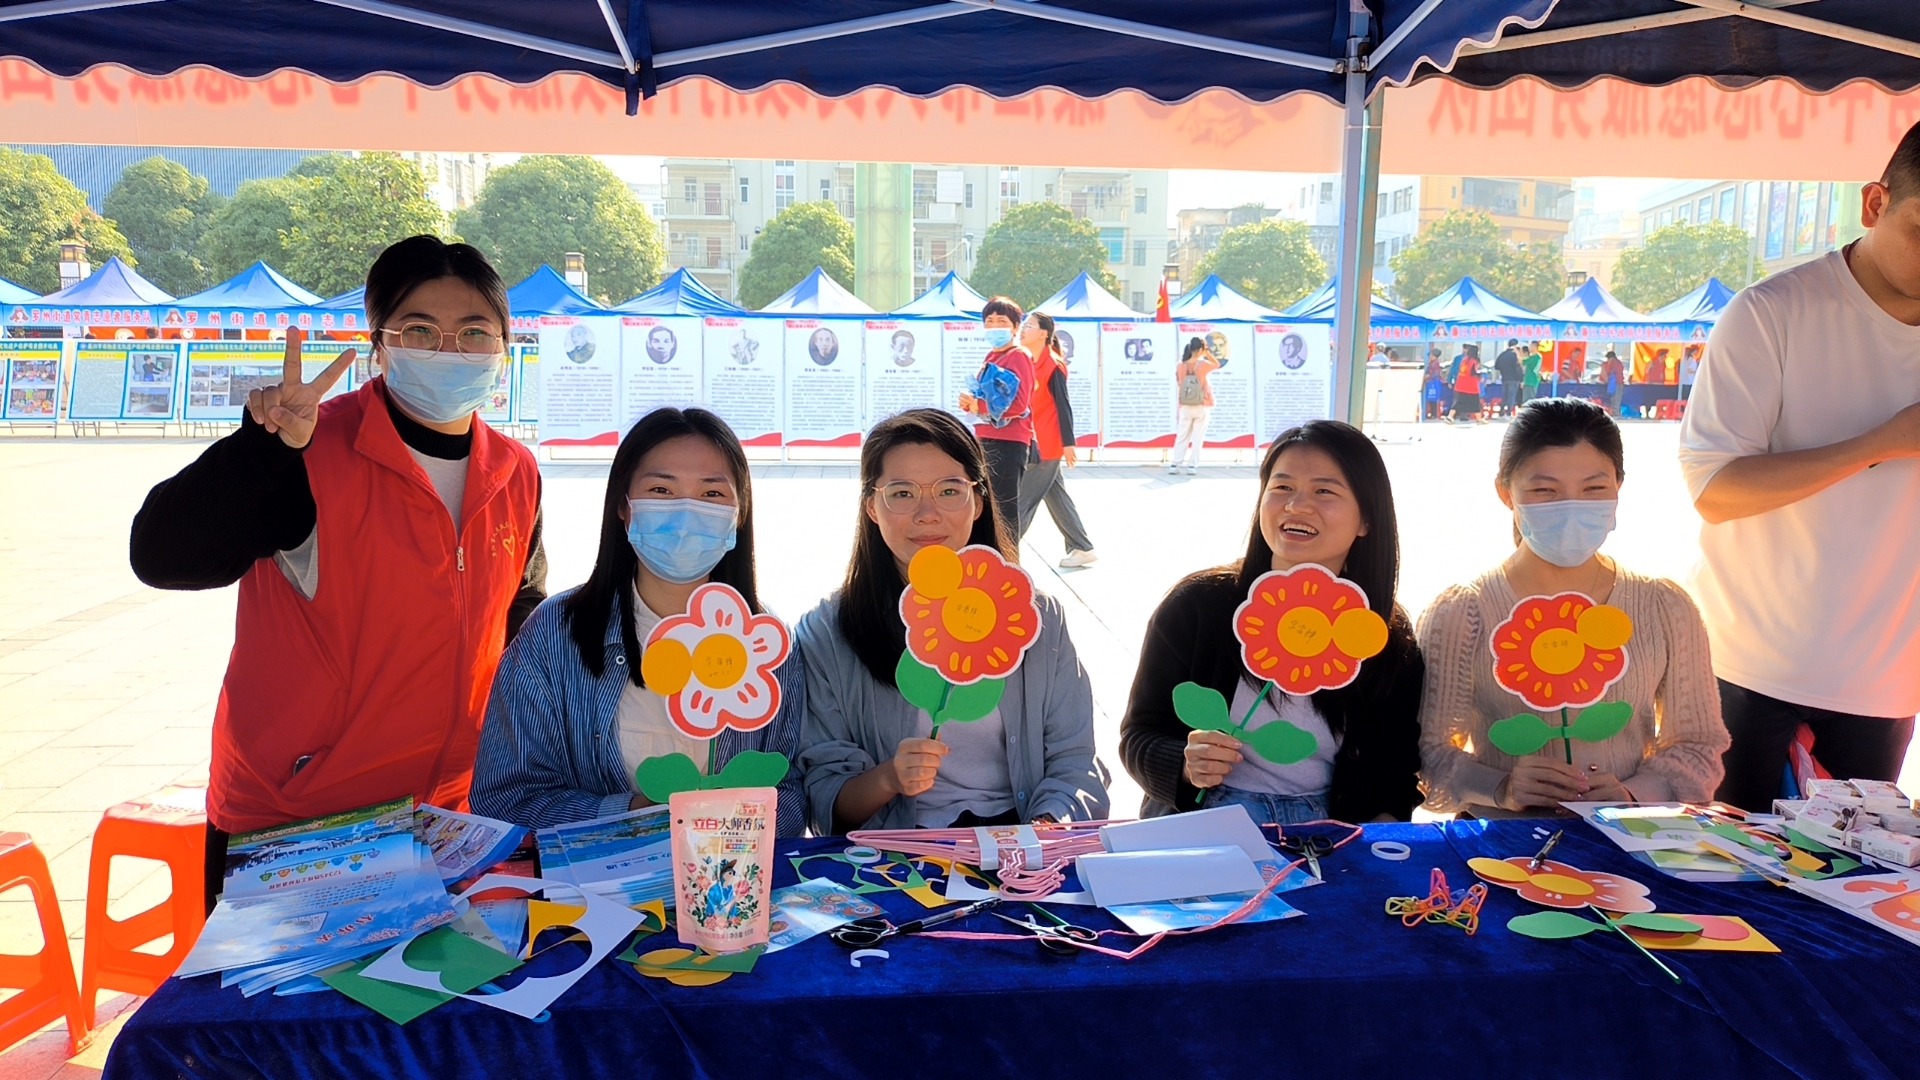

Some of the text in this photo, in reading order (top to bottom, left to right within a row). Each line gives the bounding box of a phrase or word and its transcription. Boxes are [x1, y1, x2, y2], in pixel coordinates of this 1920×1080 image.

[31, 308, 152, 323] 罗州街道常青志愿者服务队
[186, 311, 356, 327] 罗州街道南街志愿
[693, 817, 766, 831] 立白大师香氛
